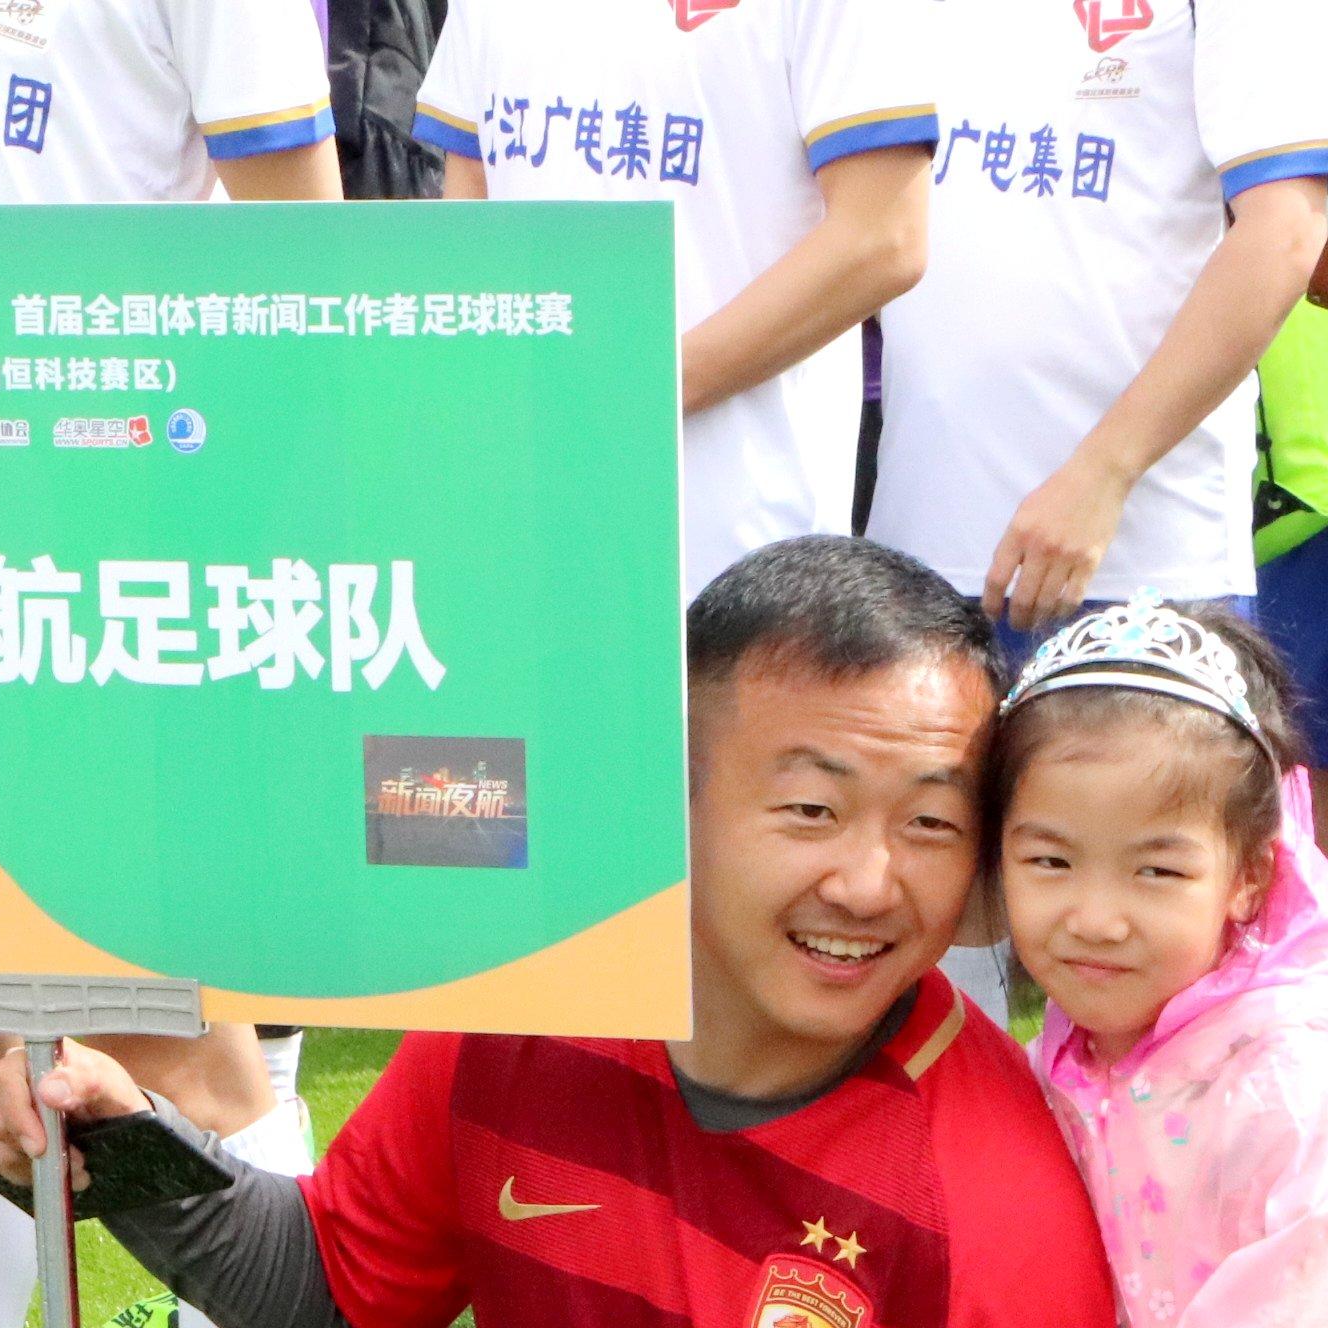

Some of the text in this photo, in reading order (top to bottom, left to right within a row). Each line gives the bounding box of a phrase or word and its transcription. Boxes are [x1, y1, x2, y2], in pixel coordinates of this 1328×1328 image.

[11, 293, 574, 337] 首届全国体育新闻工作者足球联赛
